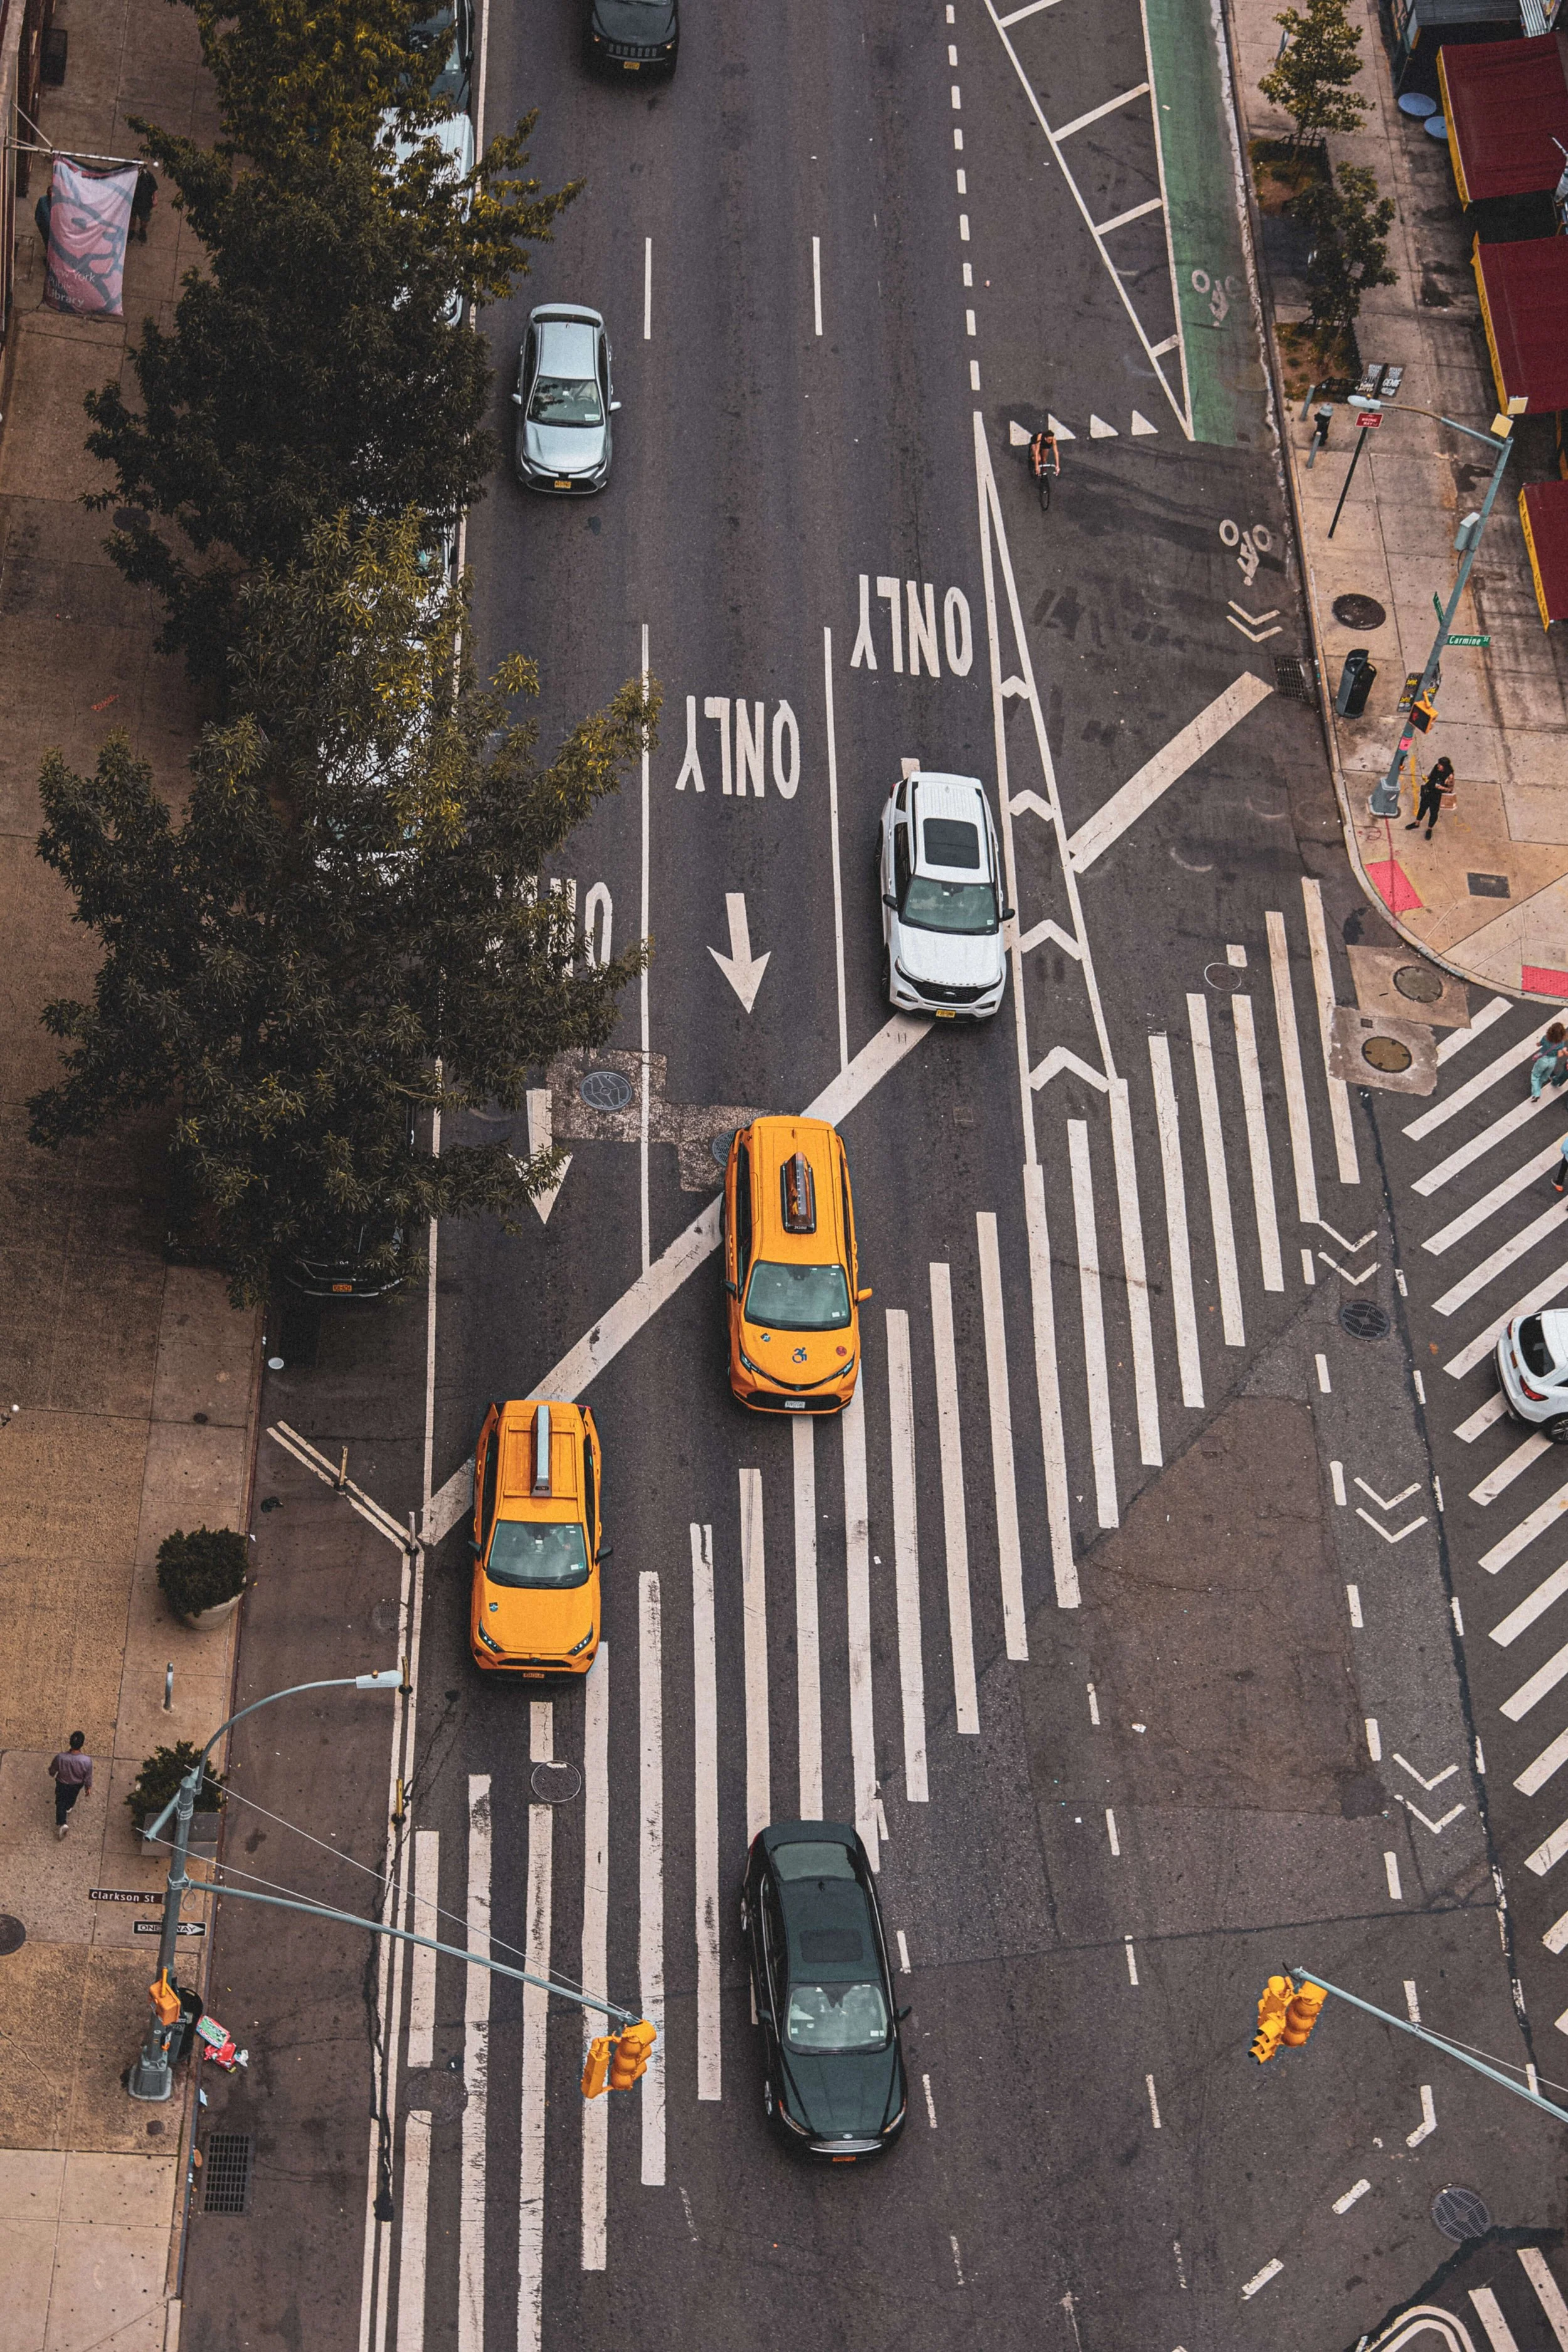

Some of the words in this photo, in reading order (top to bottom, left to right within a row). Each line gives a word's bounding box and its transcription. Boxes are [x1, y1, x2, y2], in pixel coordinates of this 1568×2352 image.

[74, 270, 95, 282] York
[47, 288, 84, 307] Library
[850, 575, 973, 677] ONLY
[1449, 635, 1481, 645] Carmine
[675, 695, 800, 799] ONLY
[91, 1891, 139, 1902] Clarkson
[144, 1895, 154, 1903] St
